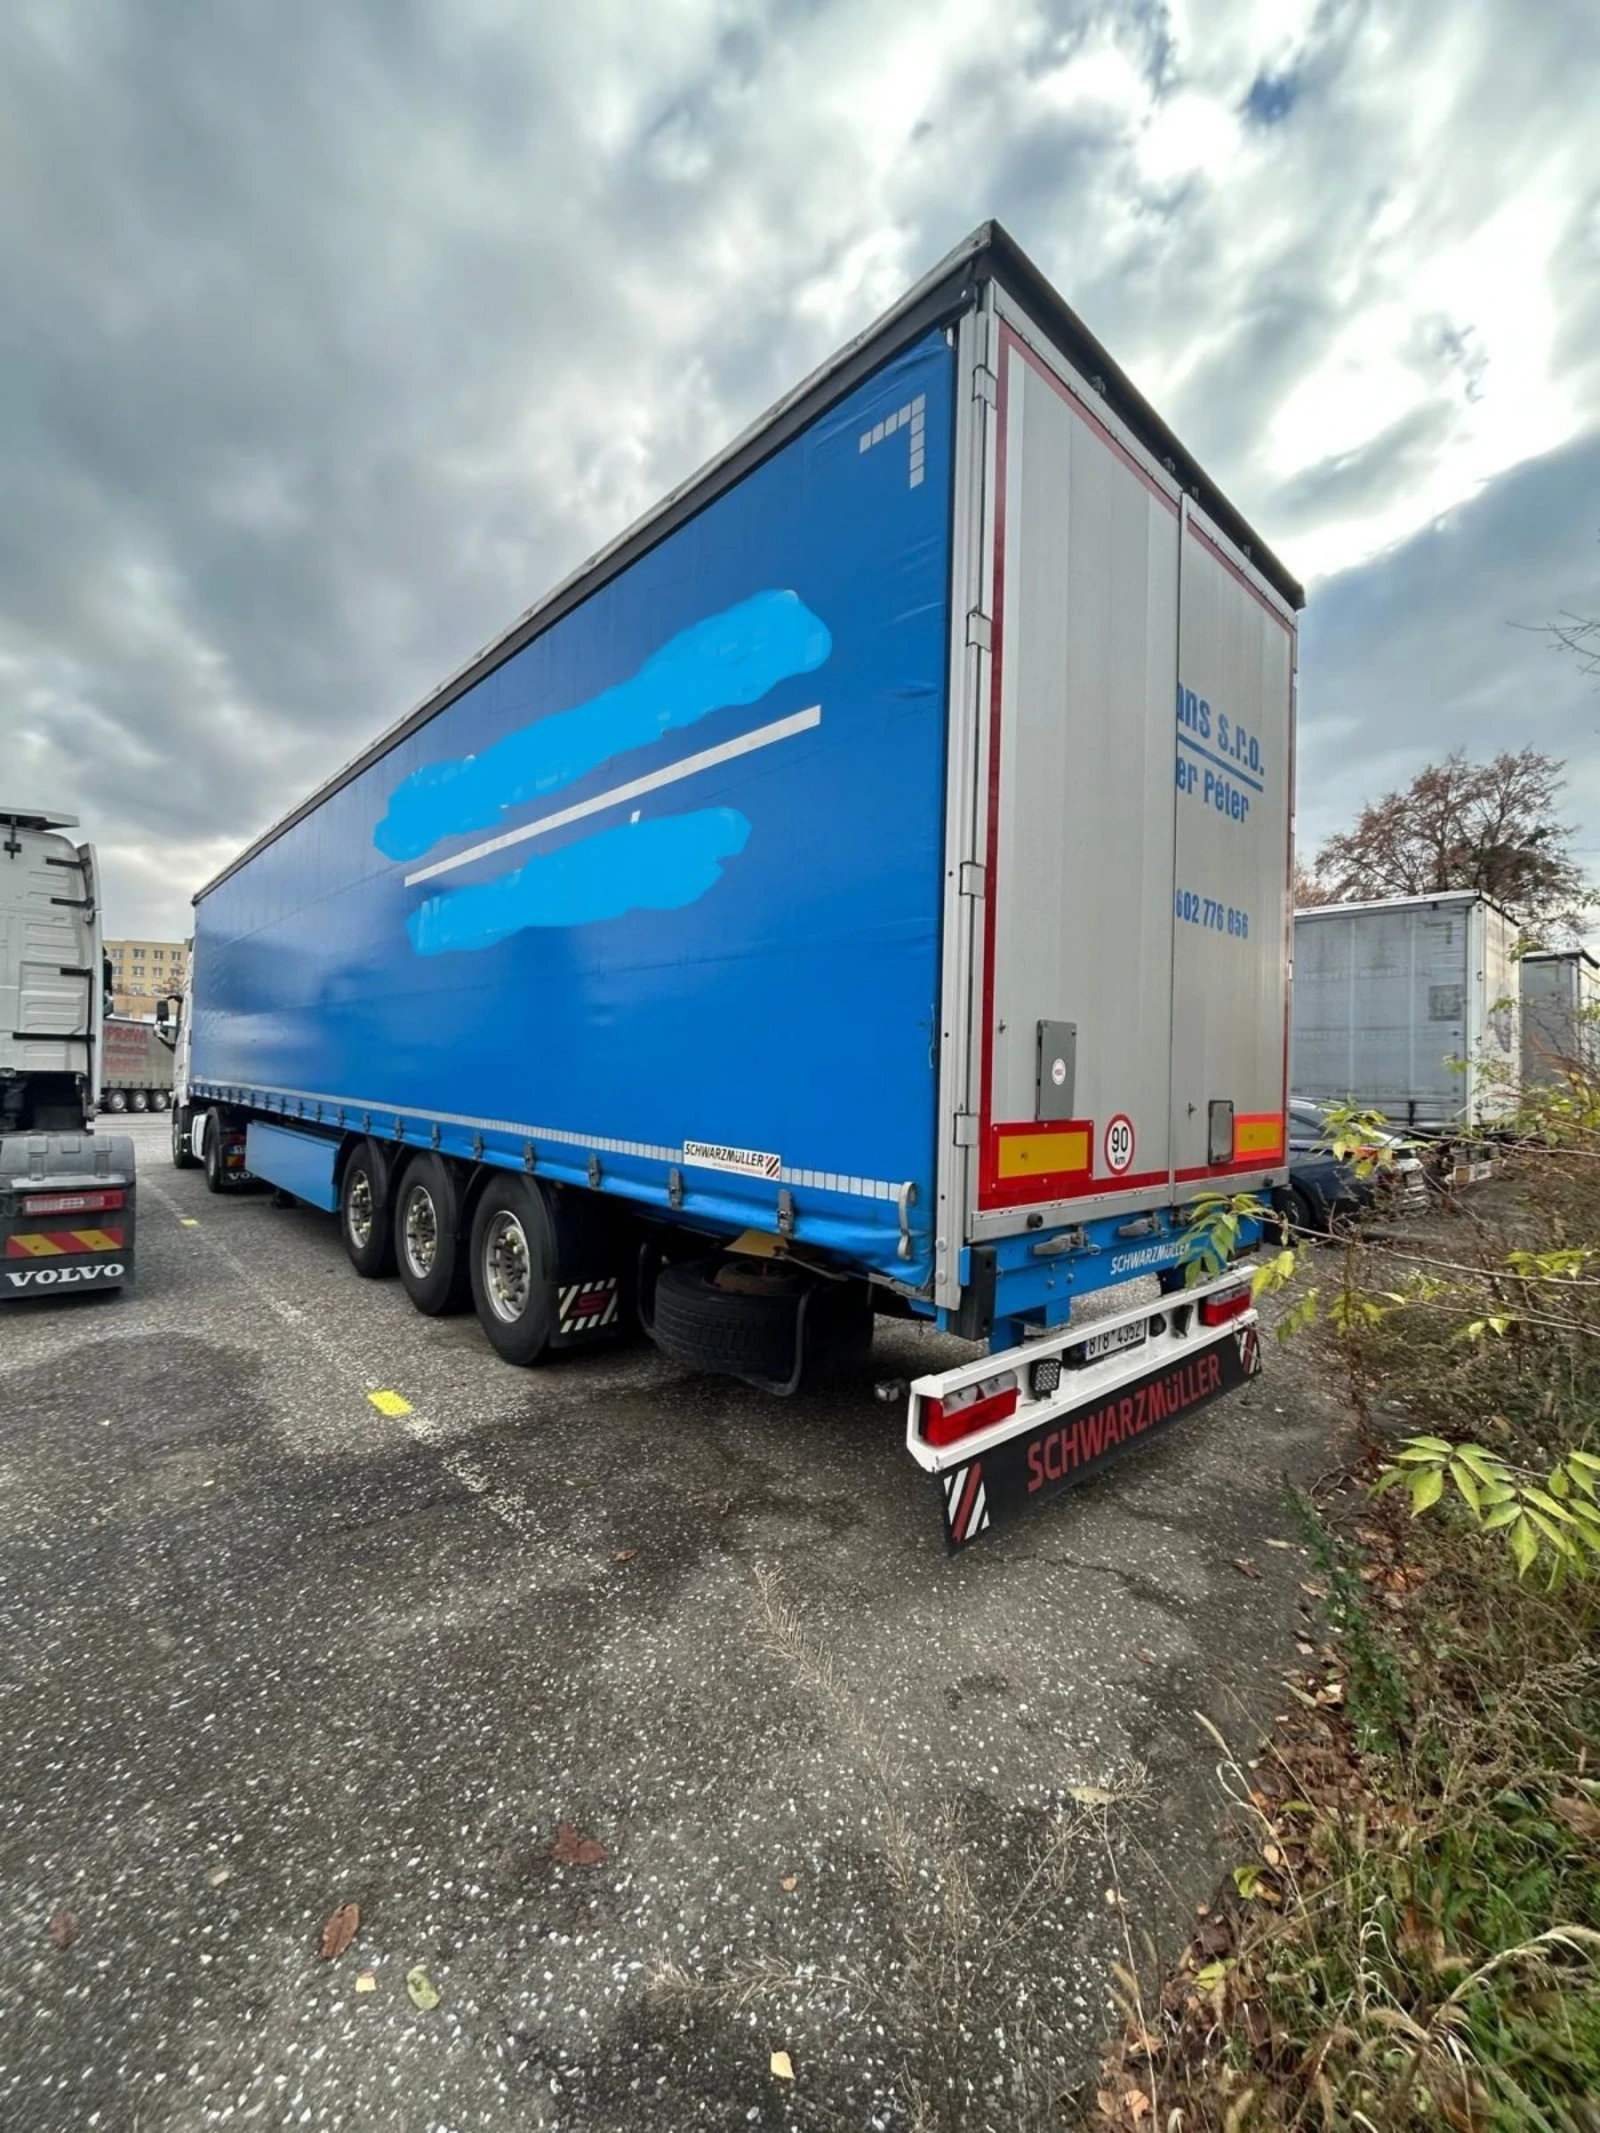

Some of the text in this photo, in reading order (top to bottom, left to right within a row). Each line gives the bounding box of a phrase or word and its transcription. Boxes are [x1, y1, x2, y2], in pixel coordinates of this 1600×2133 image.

[1218, 713, 1264, 776] s.r.o.
[1204, 767, 1249, 823] Péter
[1203, 897, 1224, 931] 776
[685, 1143, 764, 1167] SCHWARZMÜLLER
[1112, 1126, 1128, 1153] 90
[5, 1263, 125, 1287] VOLVO
[1027, 1353, 1222, 1493] SCHWARZMÜLLER
